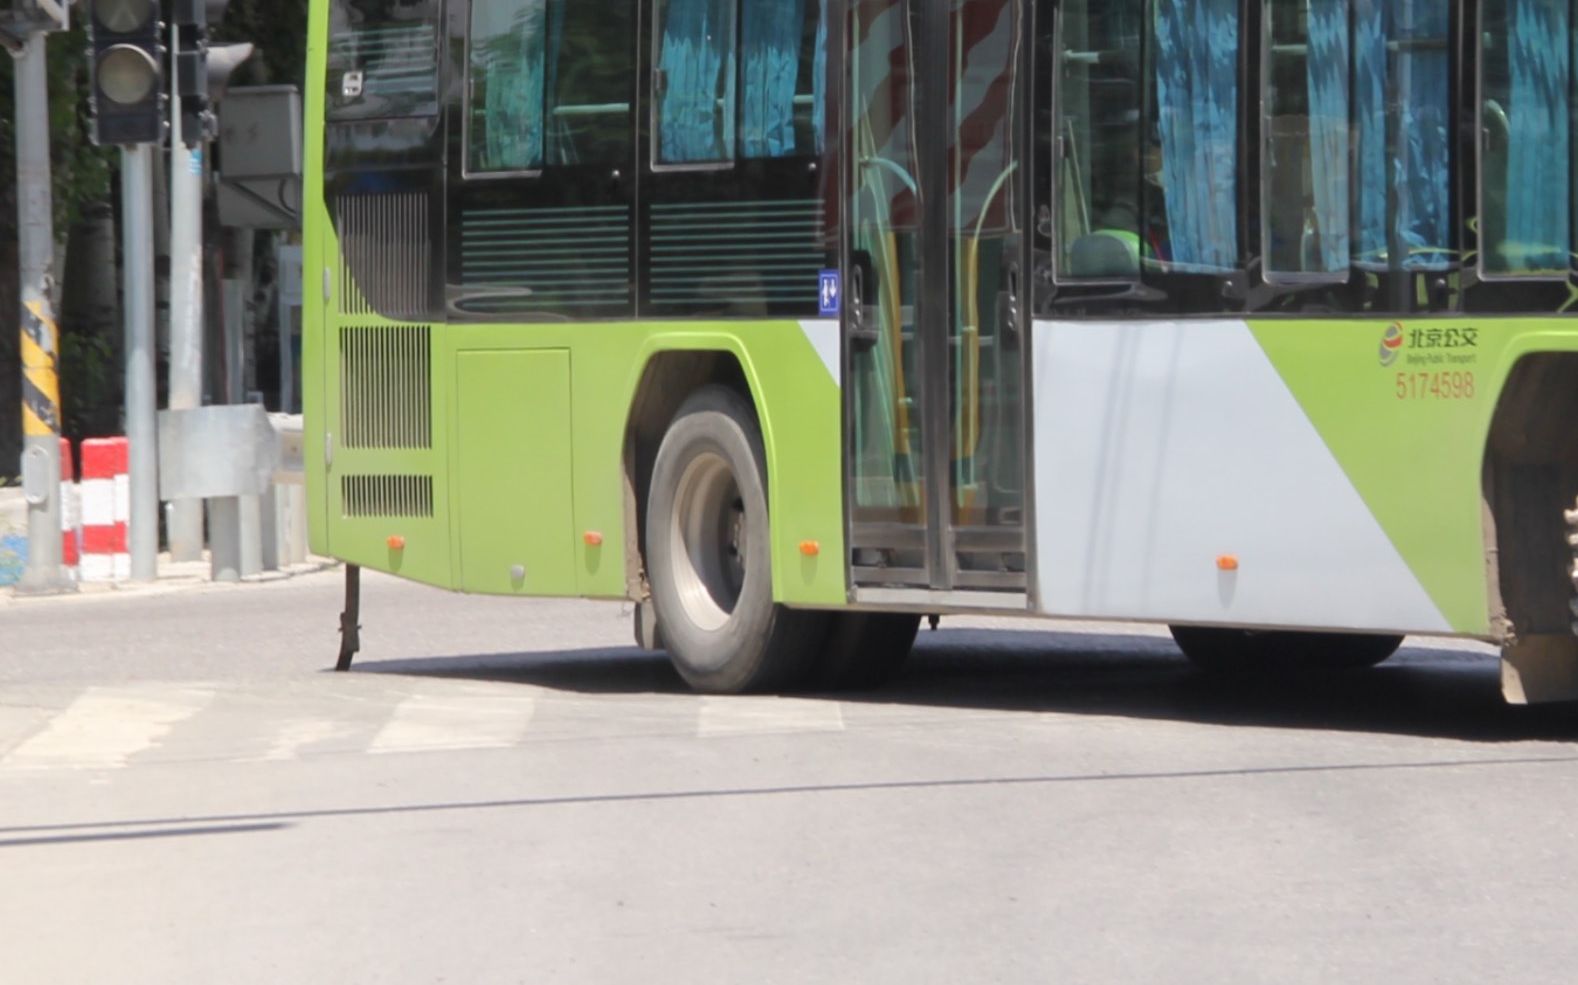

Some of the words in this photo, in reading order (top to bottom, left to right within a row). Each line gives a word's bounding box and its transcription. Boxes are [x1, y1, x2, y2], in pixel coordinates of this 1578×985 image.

[1407, 328, 1478, 348] 北京公交
[1396, 371, 1474, 399] 5174598
